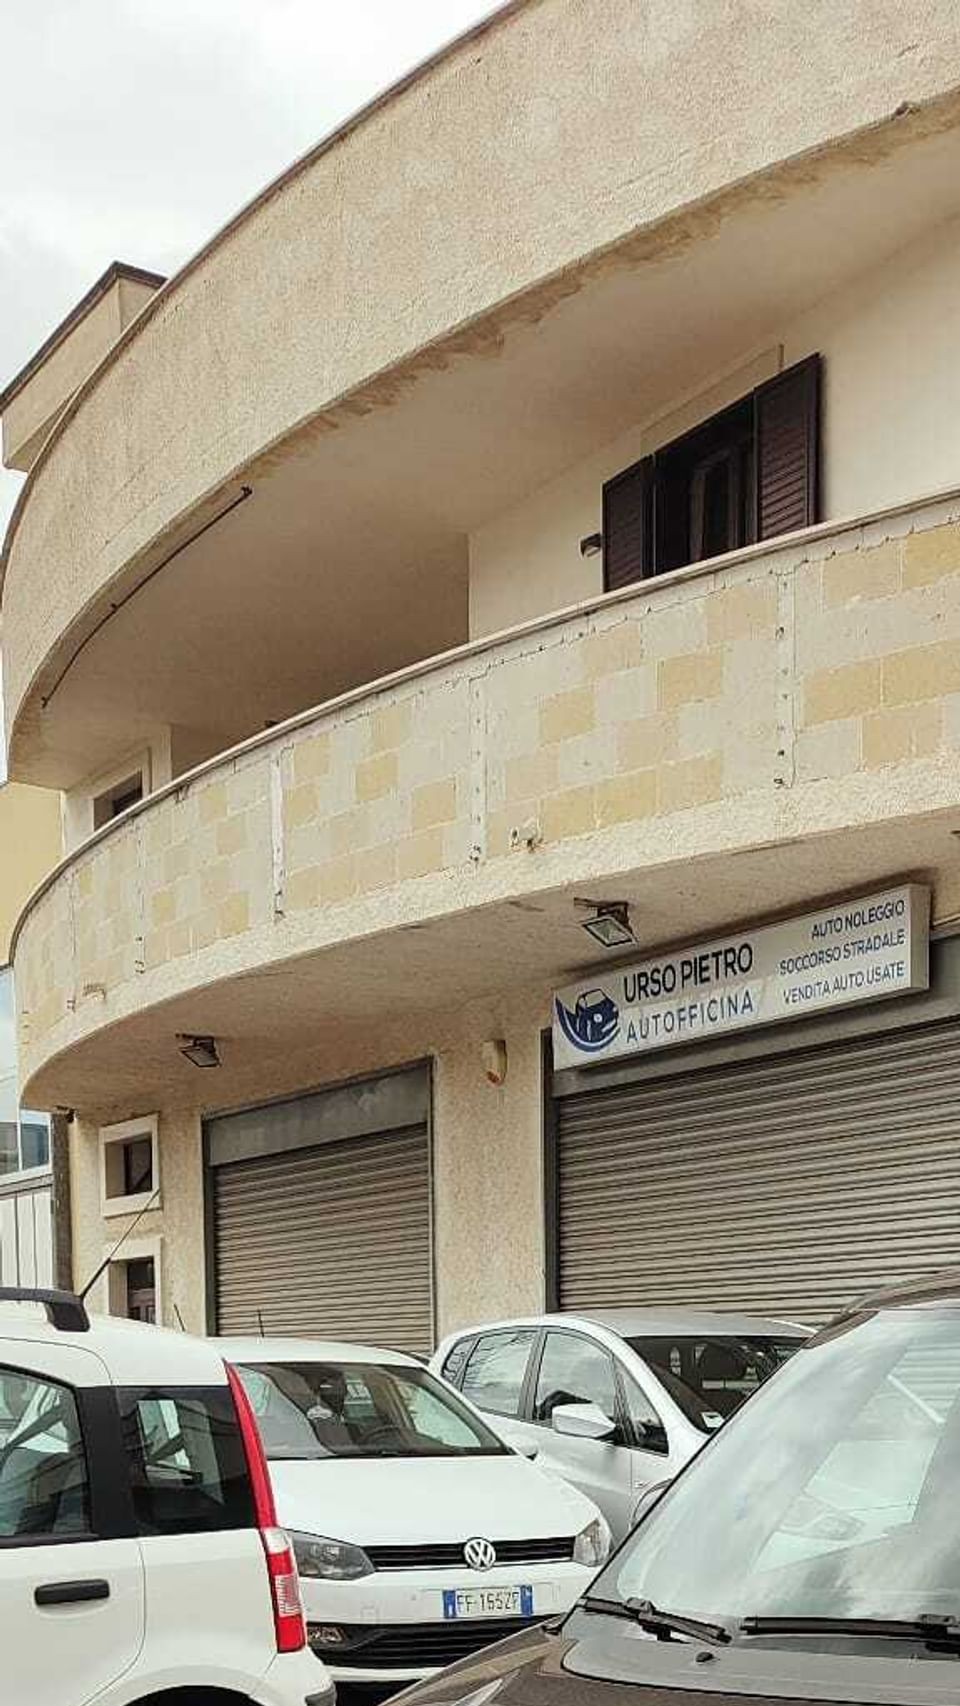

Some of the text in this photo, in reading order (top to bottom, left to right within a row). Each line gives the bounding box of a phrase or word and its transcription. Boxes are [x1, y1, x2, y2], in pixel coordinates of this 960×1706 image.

[811, 899, 905, 940] AUTO NOLEGGIO
[623, 943, 753, 1003] URSO PIETRO
[779, 928, 905, 975] SOCCORSO STRADALE
[783, 961, 905, 1005] VENDITA AUTO USATE
[626, 991, 754, 1043] AUTOFFICINA
